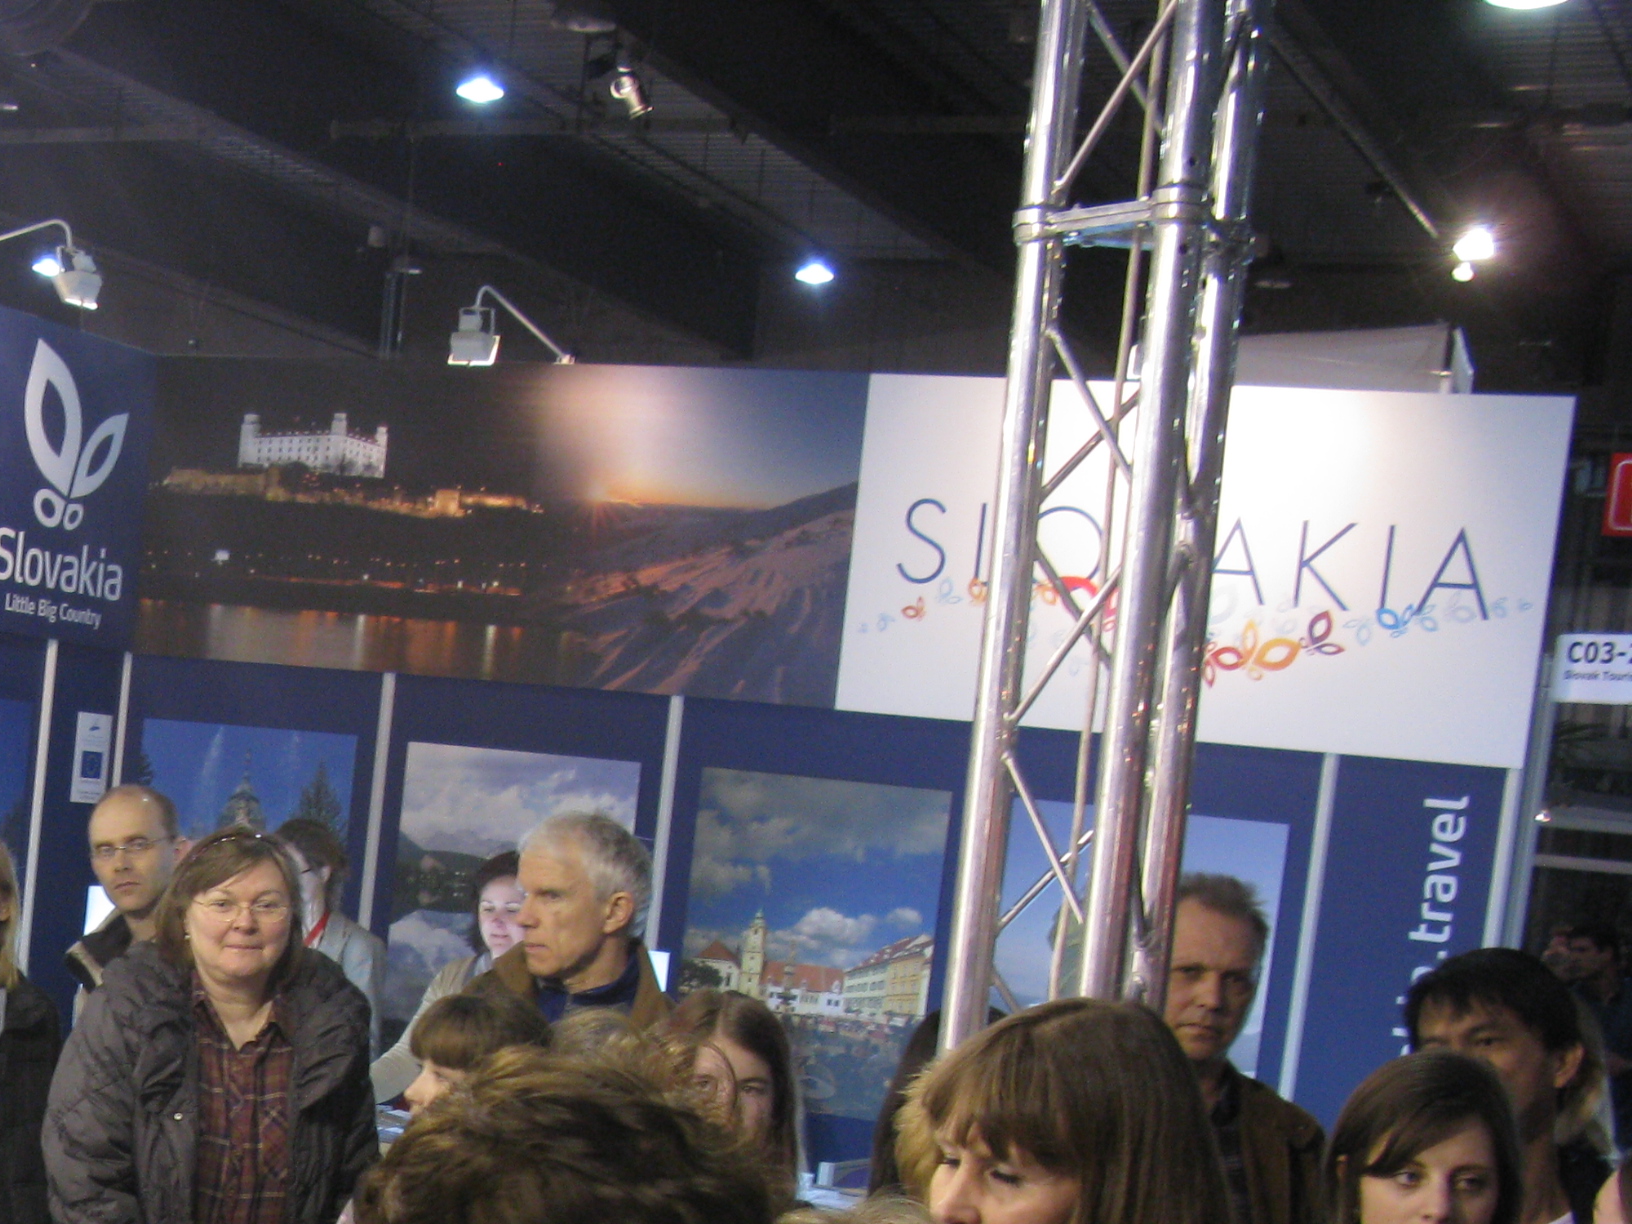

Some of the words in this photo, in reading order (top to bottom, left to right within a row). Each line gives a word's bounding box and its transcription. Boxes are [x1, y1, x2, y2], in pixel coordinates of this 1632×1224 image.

[895, 497, 1491, 621] SLOAKIA
[4, 592, 36, 615] Little
[37, 598, 58, 623] Big
[59, 603, 102, 630] Country
